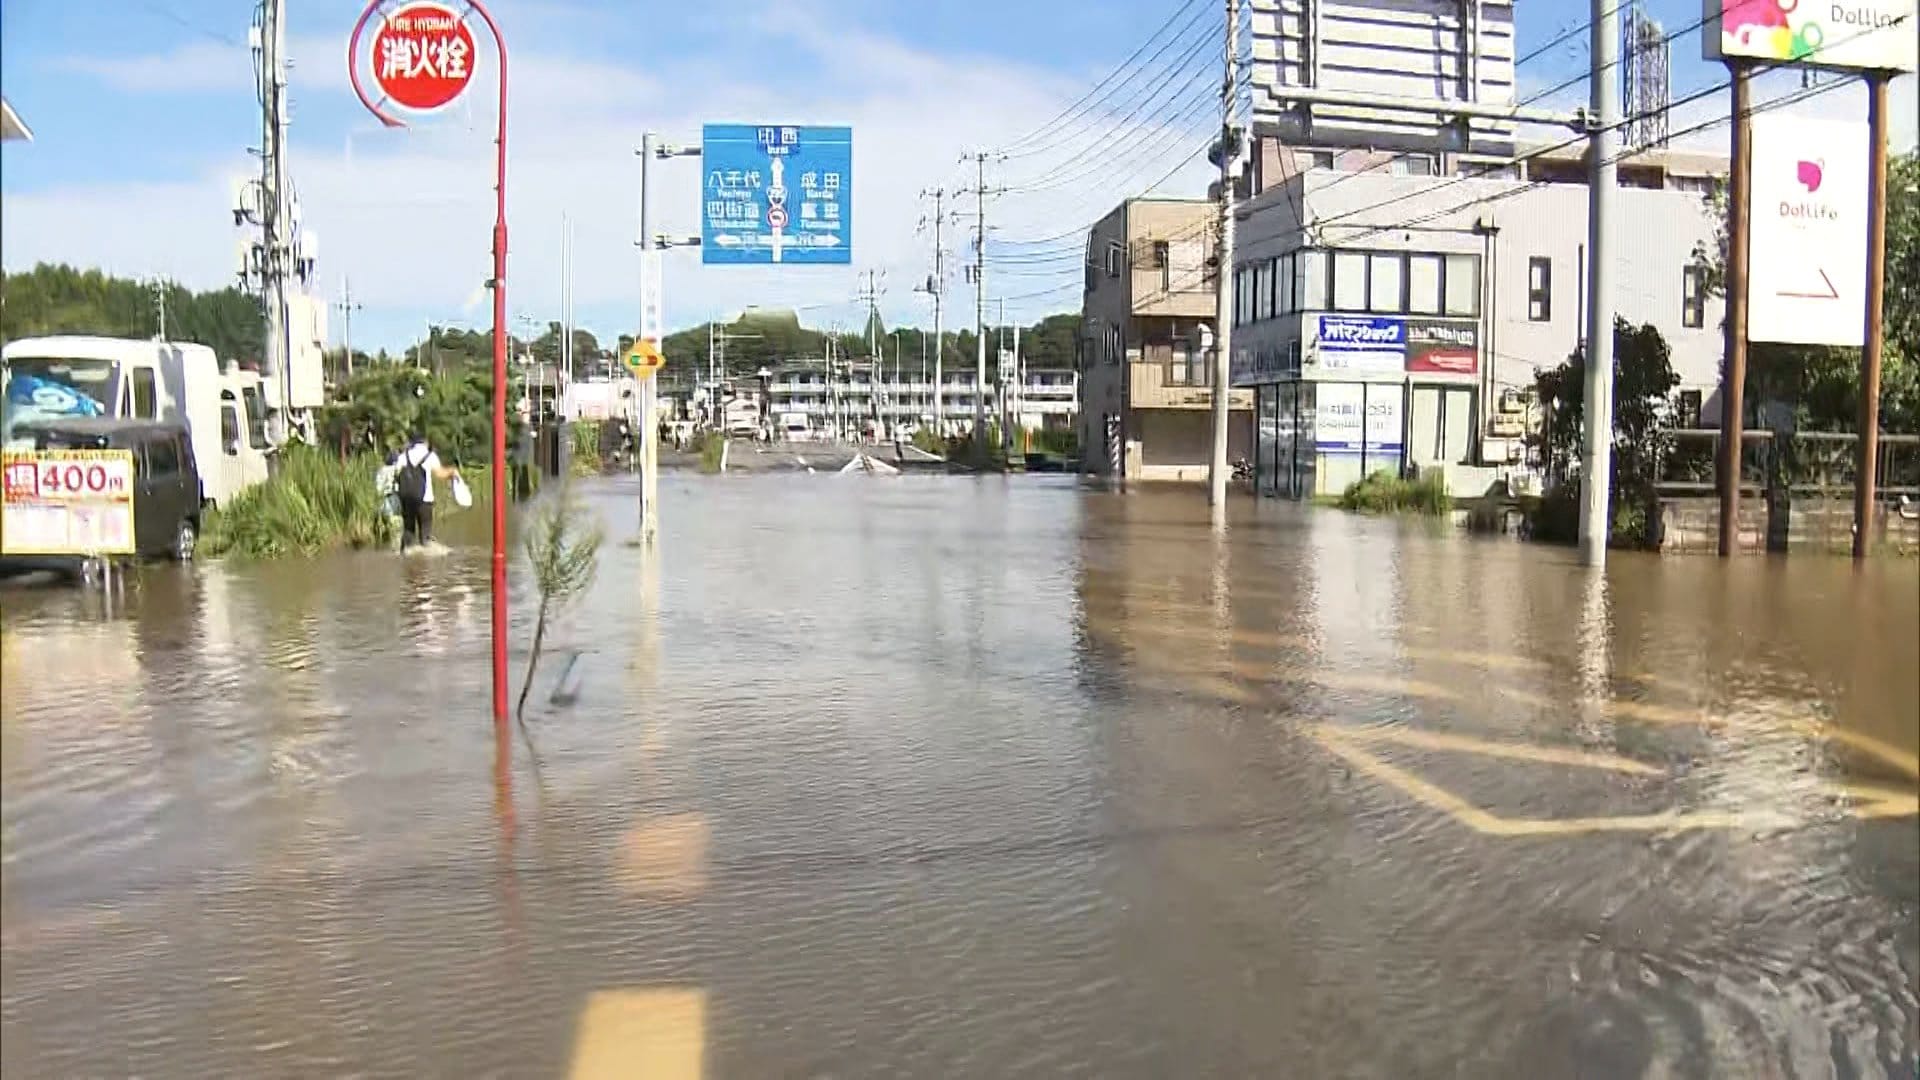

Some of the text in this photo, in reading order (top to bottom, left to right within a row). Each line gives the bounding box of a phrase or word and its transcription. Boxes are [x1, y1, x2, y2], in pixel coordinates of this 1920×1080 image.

[382, 36, 468, 78] 消火栓
[708, 170, 761, 189] 八千代
[802, 171, 840, 189] 成田
